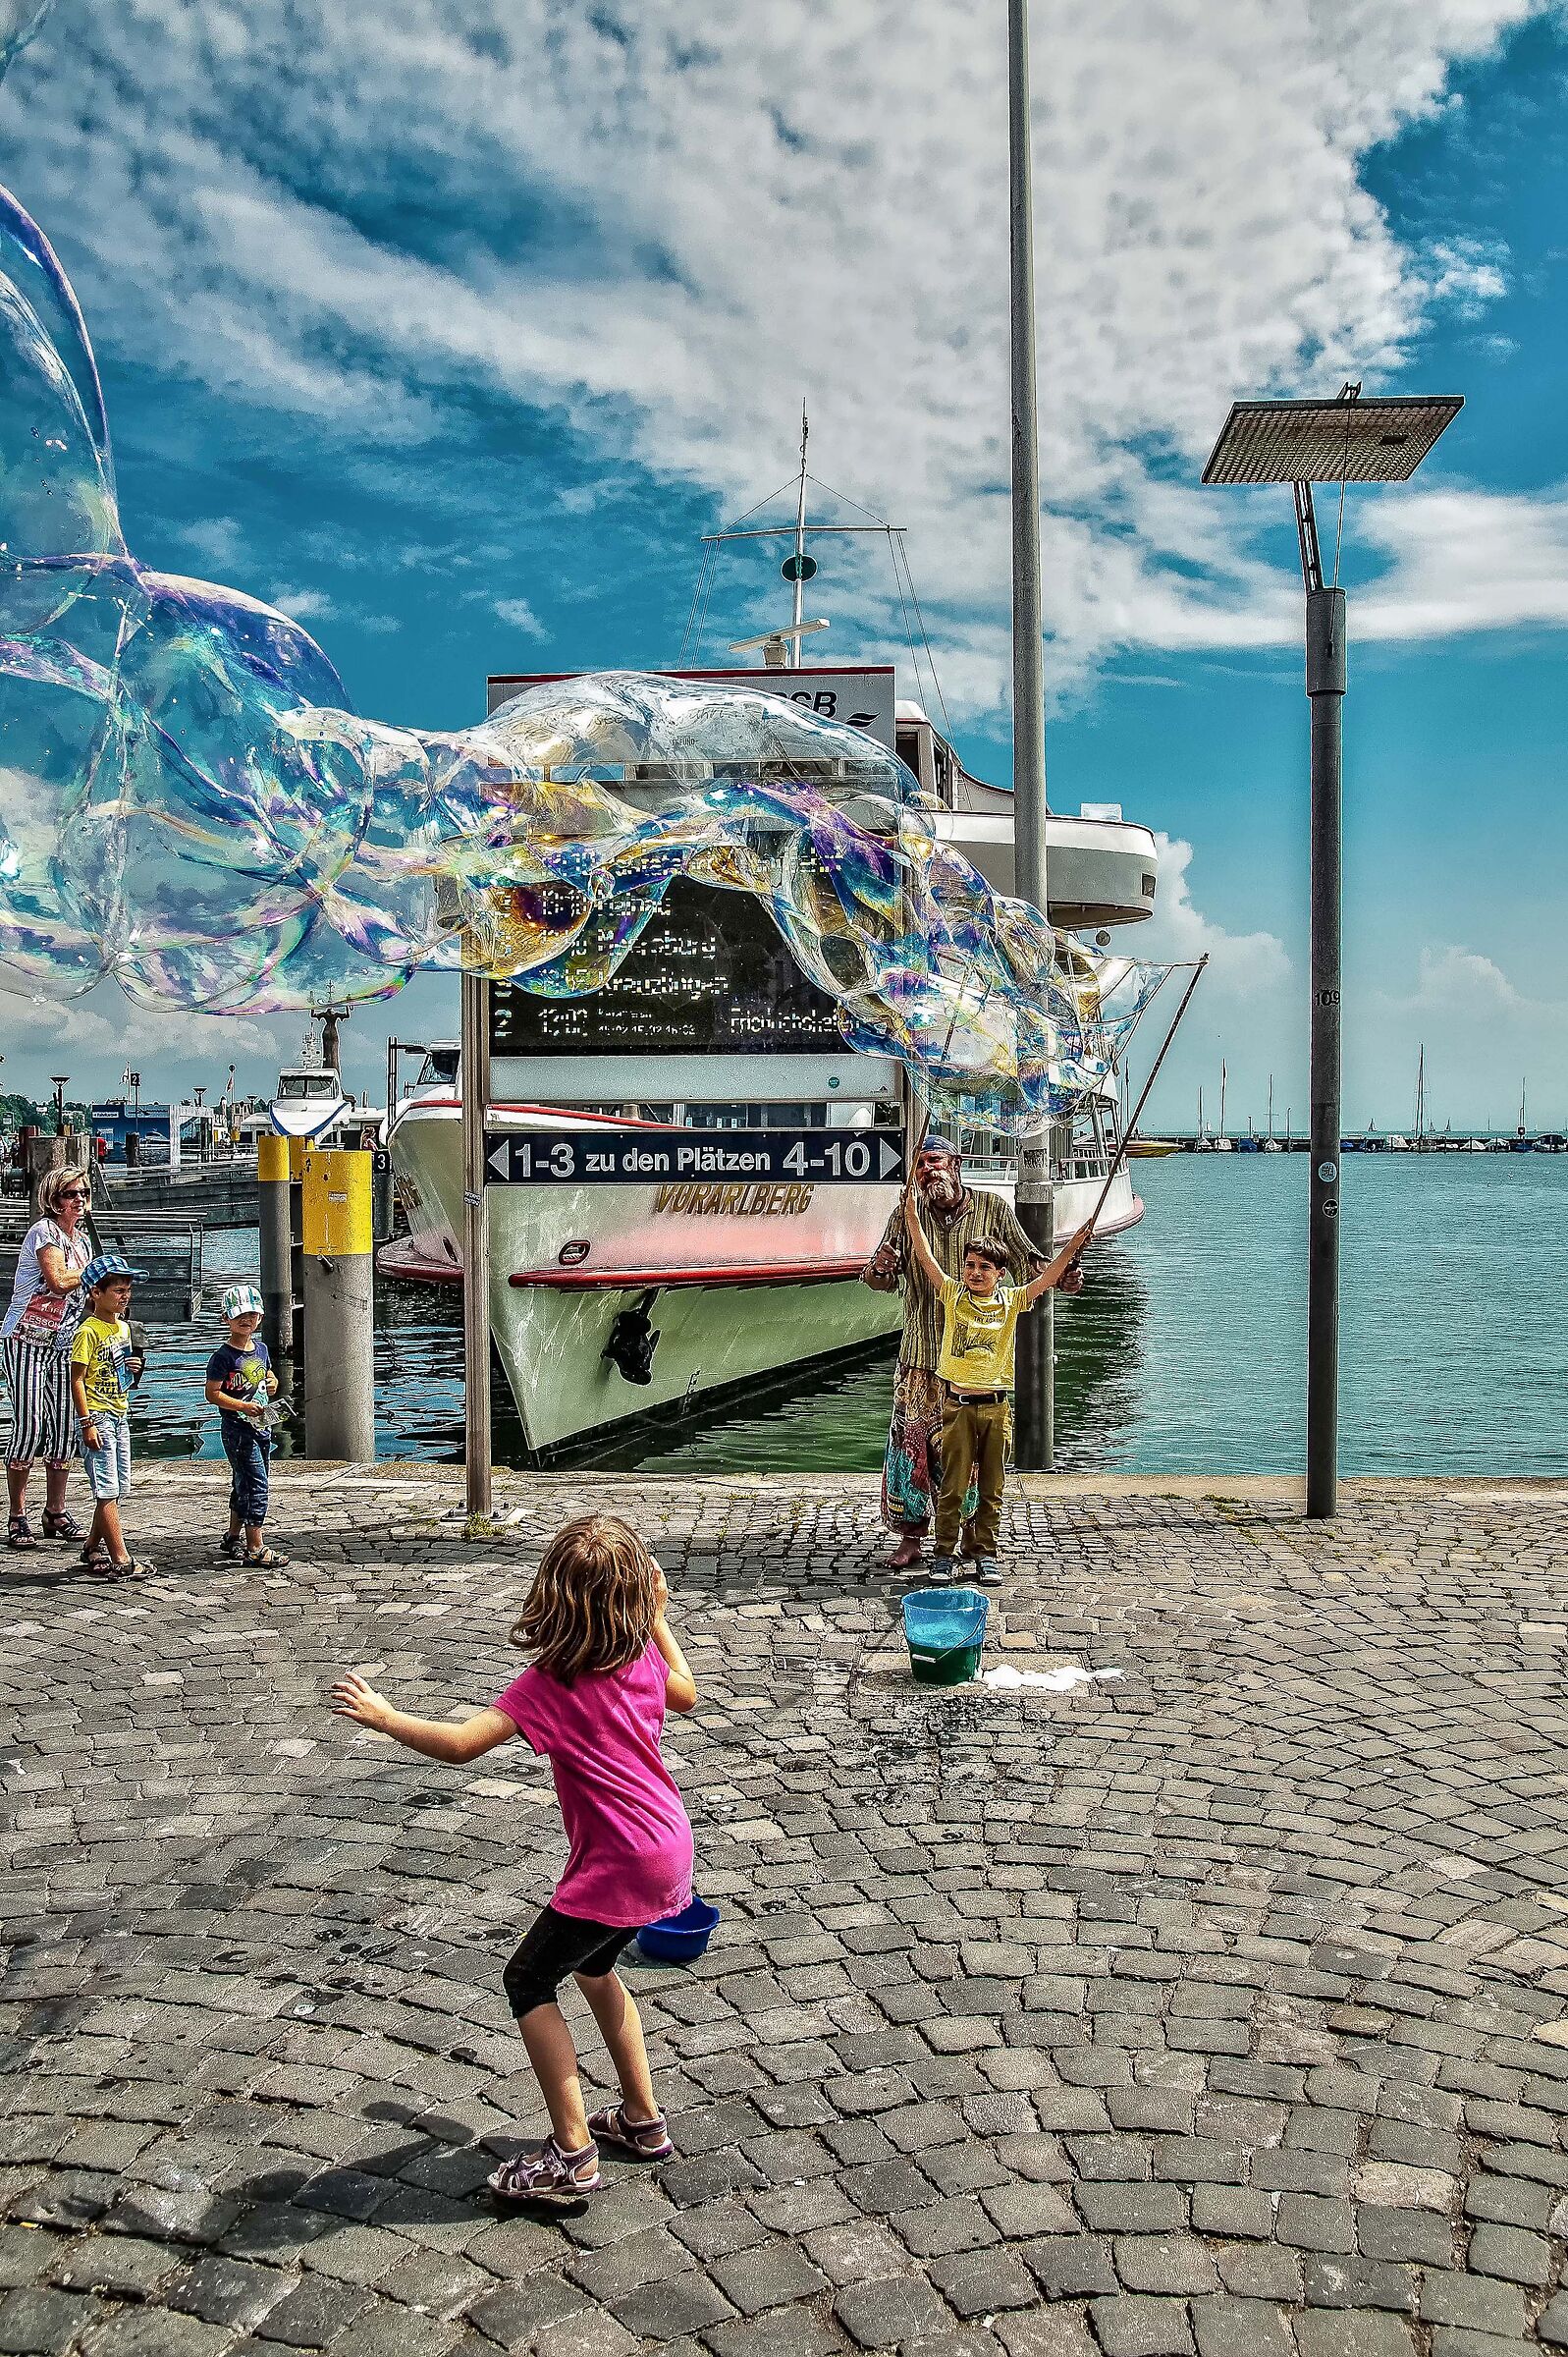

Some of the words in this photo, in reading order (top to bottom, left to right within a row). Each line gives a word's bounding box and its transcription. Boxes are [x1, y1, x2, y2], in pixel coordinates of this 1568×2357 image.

[769, 690, 838, 719] SB
[377, 1153, 386, 1170] 3
[514, 1143, 575, 1178] 1-3
[585, 1153, 616, 1172] zu
[622, 1147, 670, 1172] den
[676, 1146, 771, 1172] Plätzen
[783, 1141, 871, 1177] 4-10
[655, 1183, 815, 1216] VORARLBERG
